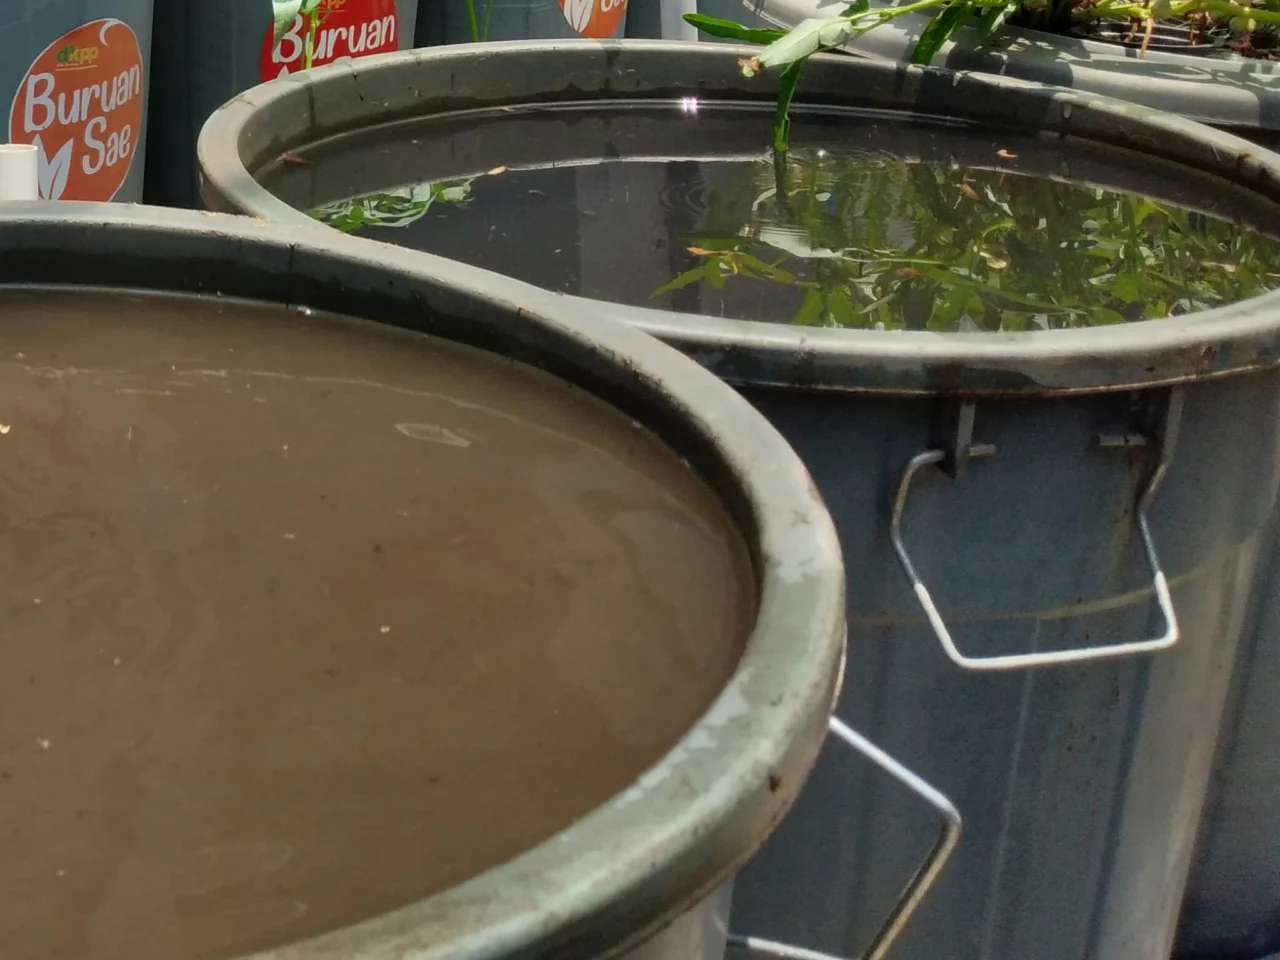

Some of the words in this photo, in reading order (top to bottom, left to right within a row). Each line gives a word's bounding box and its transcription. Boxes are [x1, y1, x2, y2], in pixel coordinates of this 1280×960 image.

[271, 13, 395, 63] Buruan
[24, 64, 140, 133] Buruan
[82, 116, 131, 175] Sae
